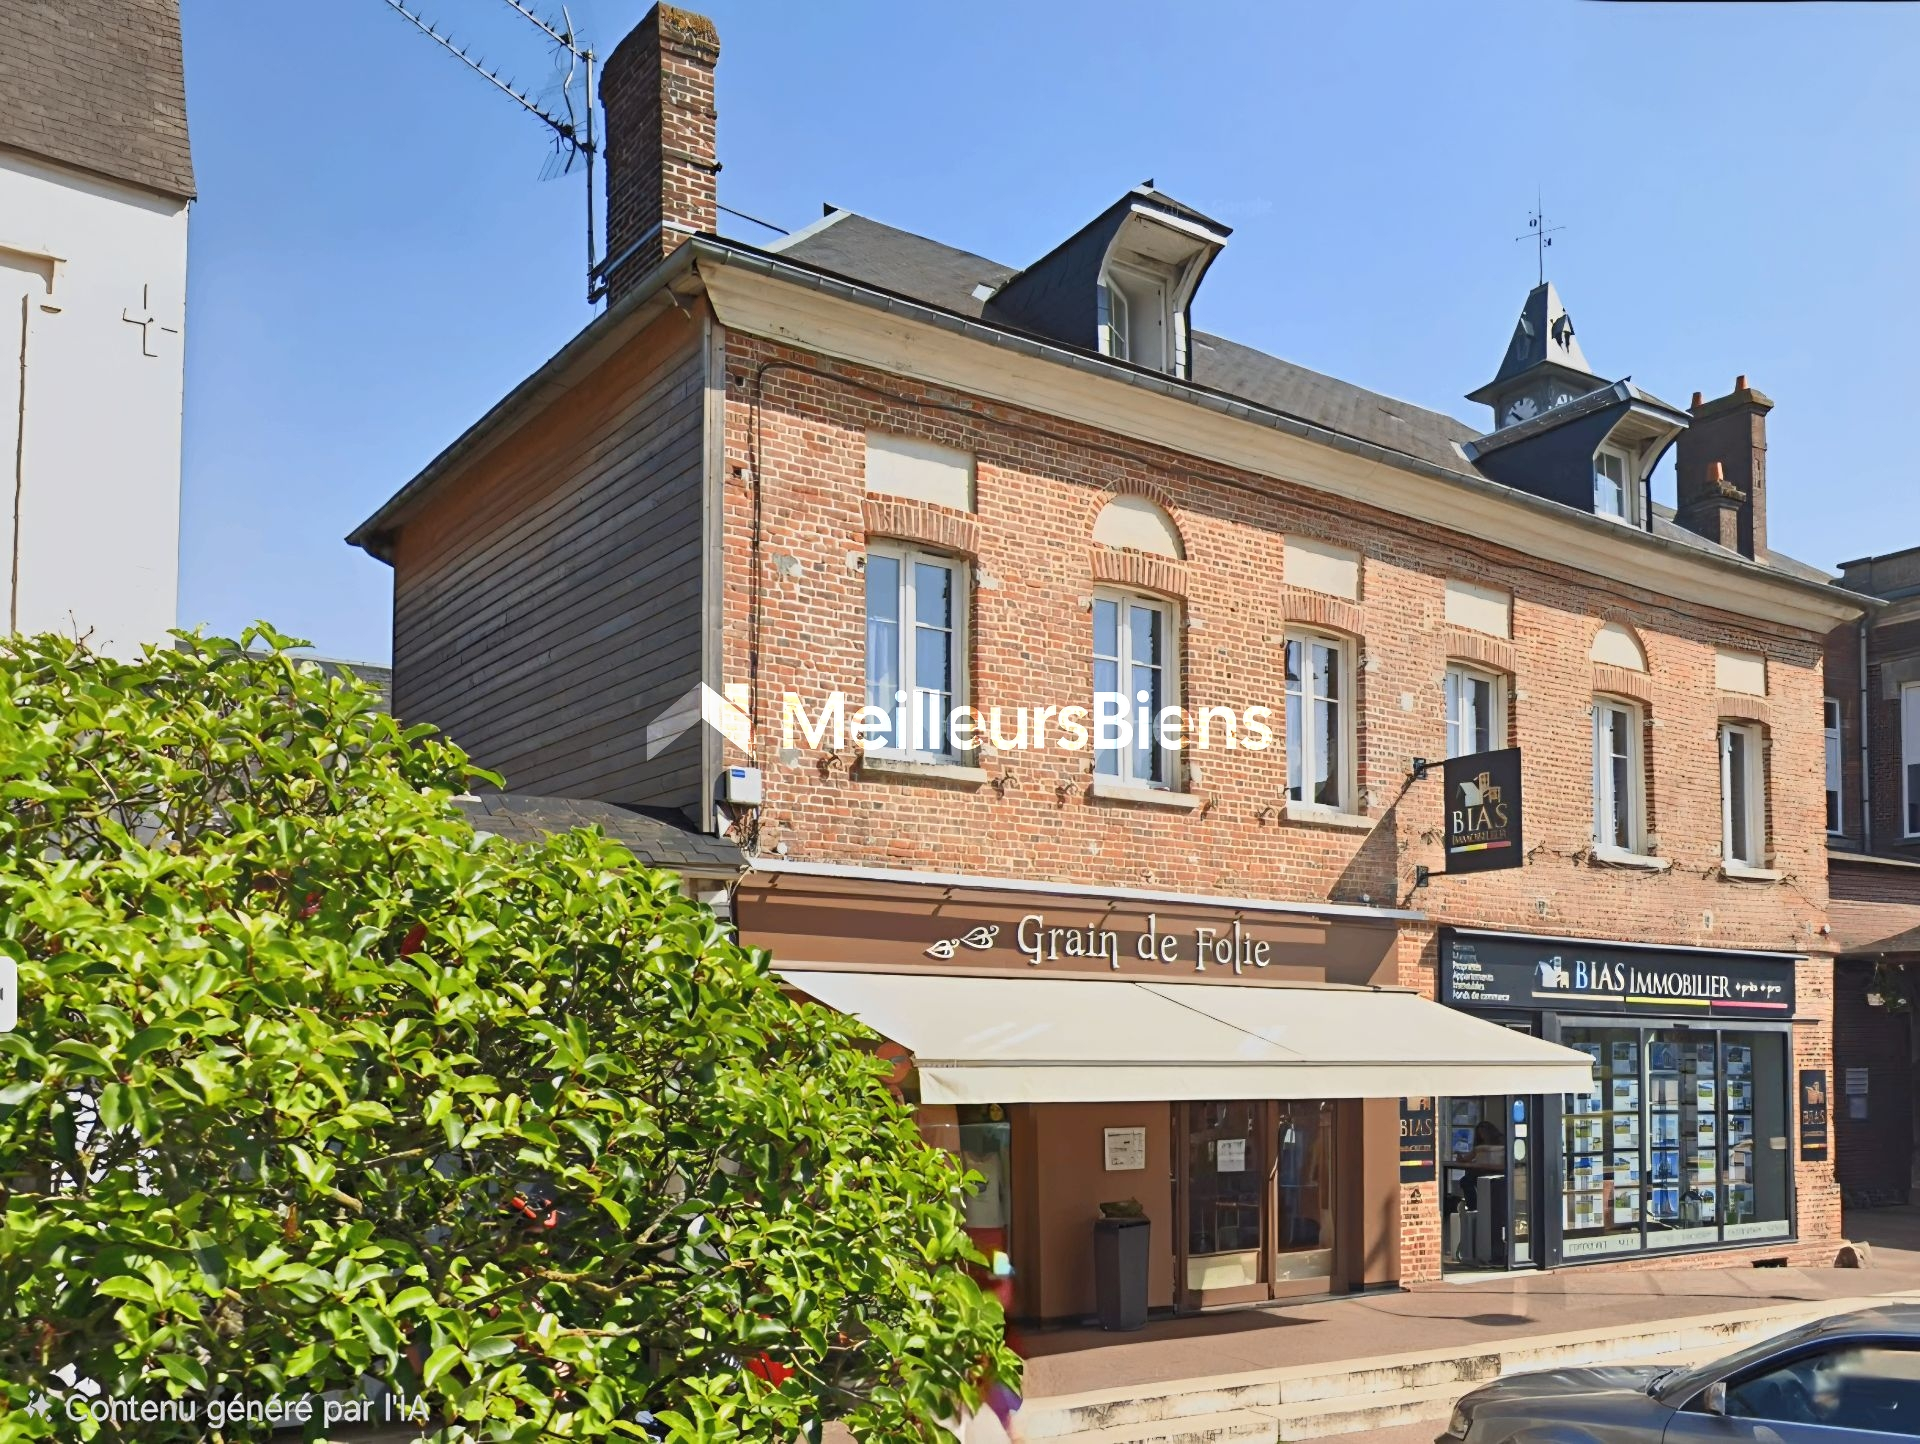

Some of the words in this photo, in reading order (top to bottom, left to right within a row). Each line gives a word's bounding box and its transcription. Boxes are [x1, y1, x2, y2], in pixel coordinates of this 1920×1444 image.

[1452, 803, 1508, 834] BIAS
[1017, 914, 1120, 970] Grain
[1137, 913, 1179, 963] de
[1195, 919, 1271, 975] Folie
[1575, 960, 1625, 991] BIAS
[1629, 966, 1732, 998] IMMOBILIER
[1400, 1118, 1432, 1137] BIAS
